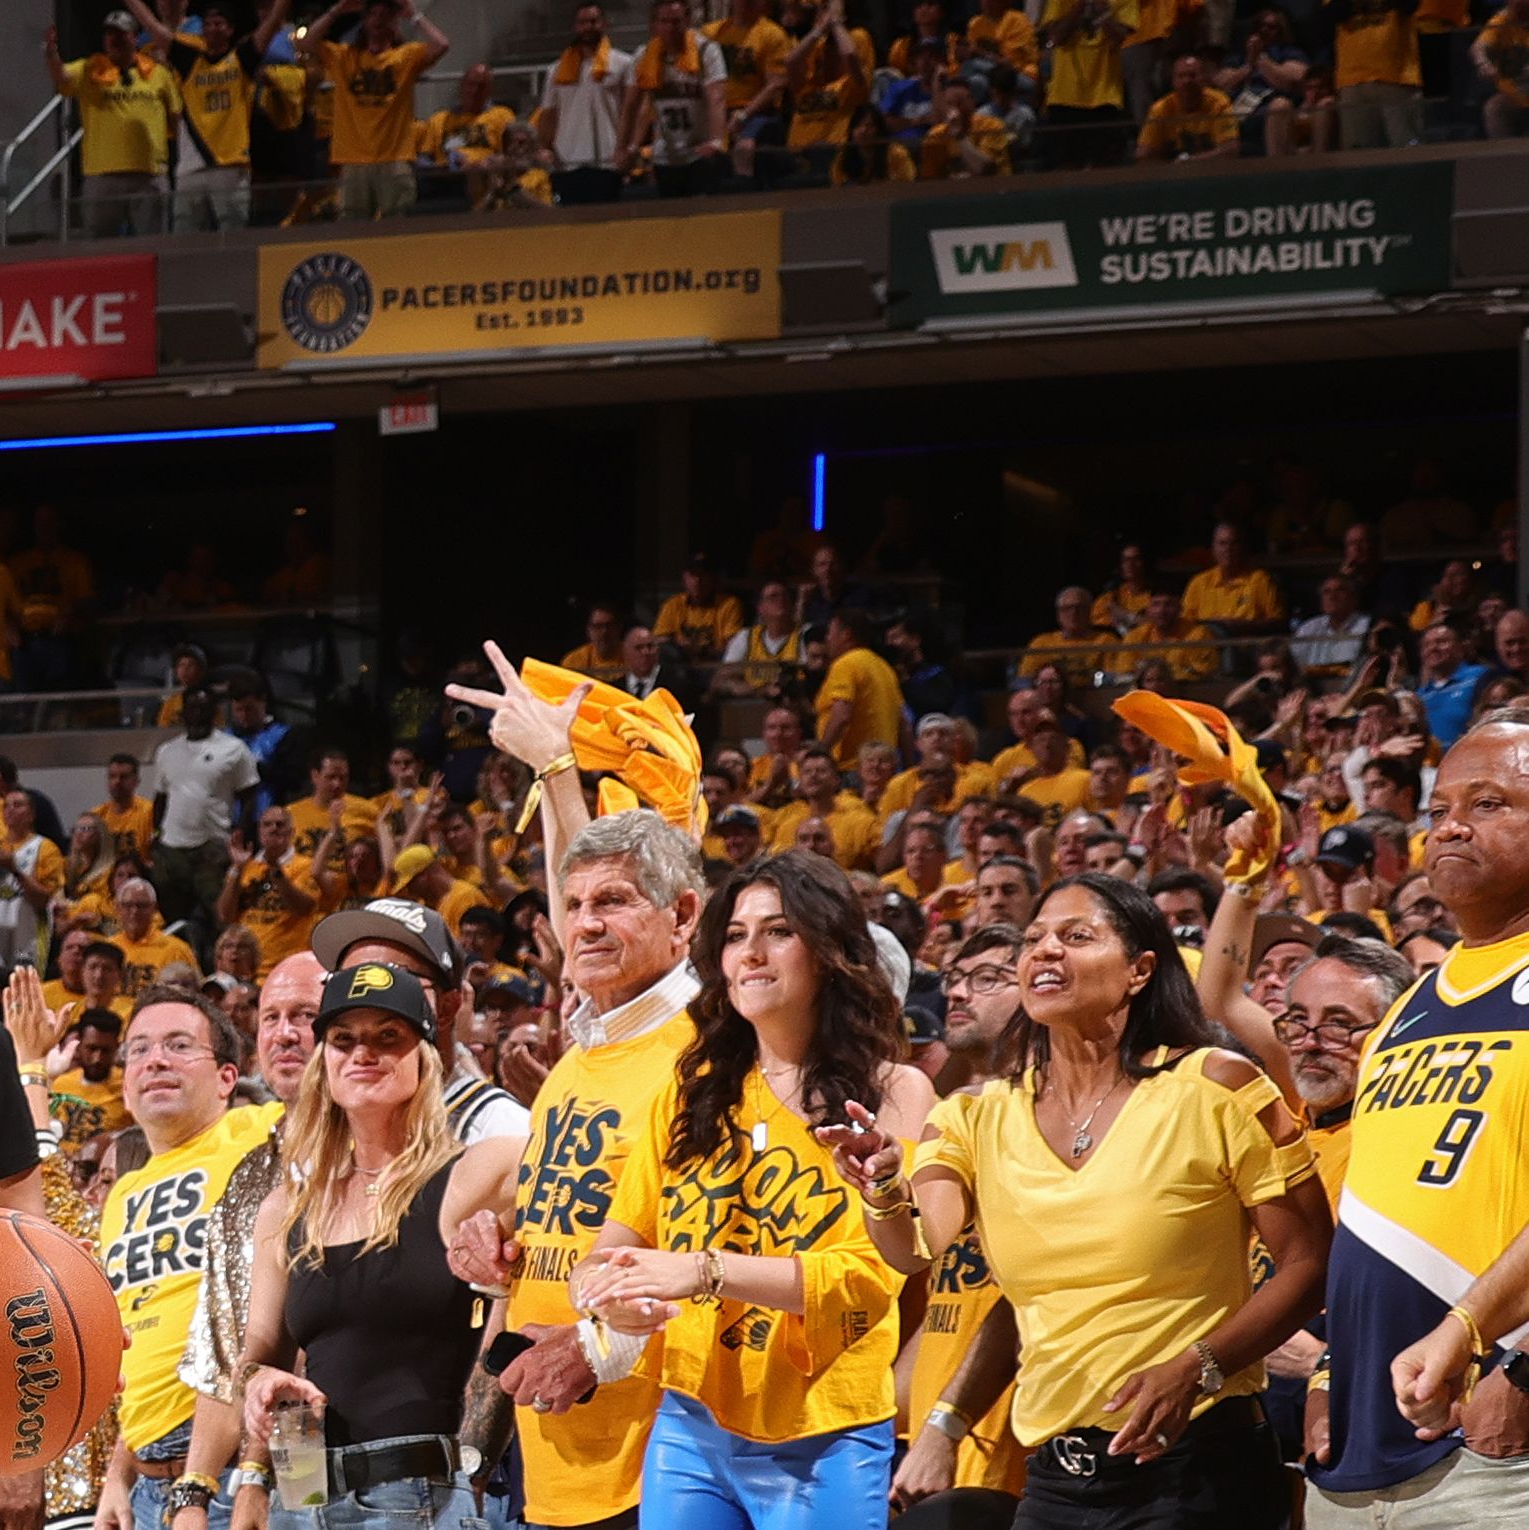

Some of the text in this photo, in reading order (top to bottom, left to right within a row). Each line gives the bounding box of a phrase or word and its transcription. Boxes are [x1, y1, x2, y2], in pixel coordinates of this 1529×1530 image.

[1225, 199, 1376, 238] DRIVING
[952, 240, 1055, 274] WM
[1100, 236, 1390, 285] SUSTAINABILITY
[381, 267, 761, 310] PACERSFOUNDATION.org
[475, 312, 520, 332] Est.
[1354, 1040, 1513, 1120] PACERS
[541, 1096, 621, 1168] YES
[1416, 1108, 1489, 1190] 9
[124, 1171, 205, 1236] YES
[667, 1132, 848, 1251] OOM
[526, 1246, 579, 1281] FINALS
[4, 1287, 62, 1462] Wilson
